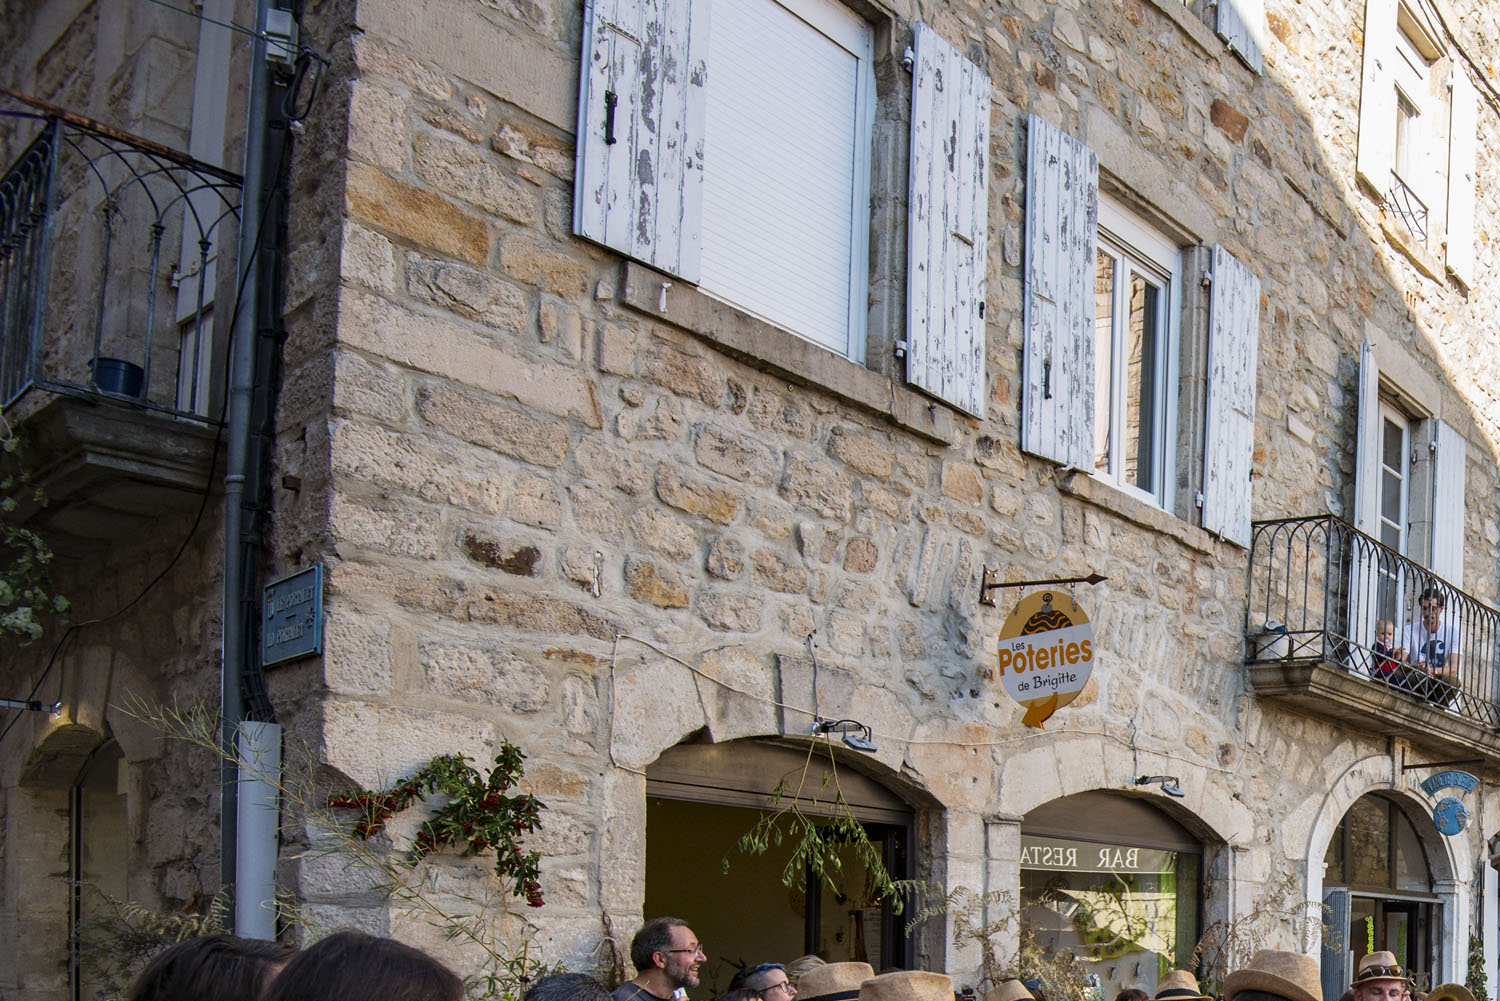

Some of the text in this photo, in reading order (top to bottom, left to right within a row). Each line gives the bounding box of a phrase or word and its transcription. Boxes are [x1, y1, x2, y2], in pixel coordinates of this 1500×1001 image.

[1012, 641, 1025, 651] Les
[999, 638, 1093, 676] Poteries
[1018, 671, 1077, 692] de Brigitte
